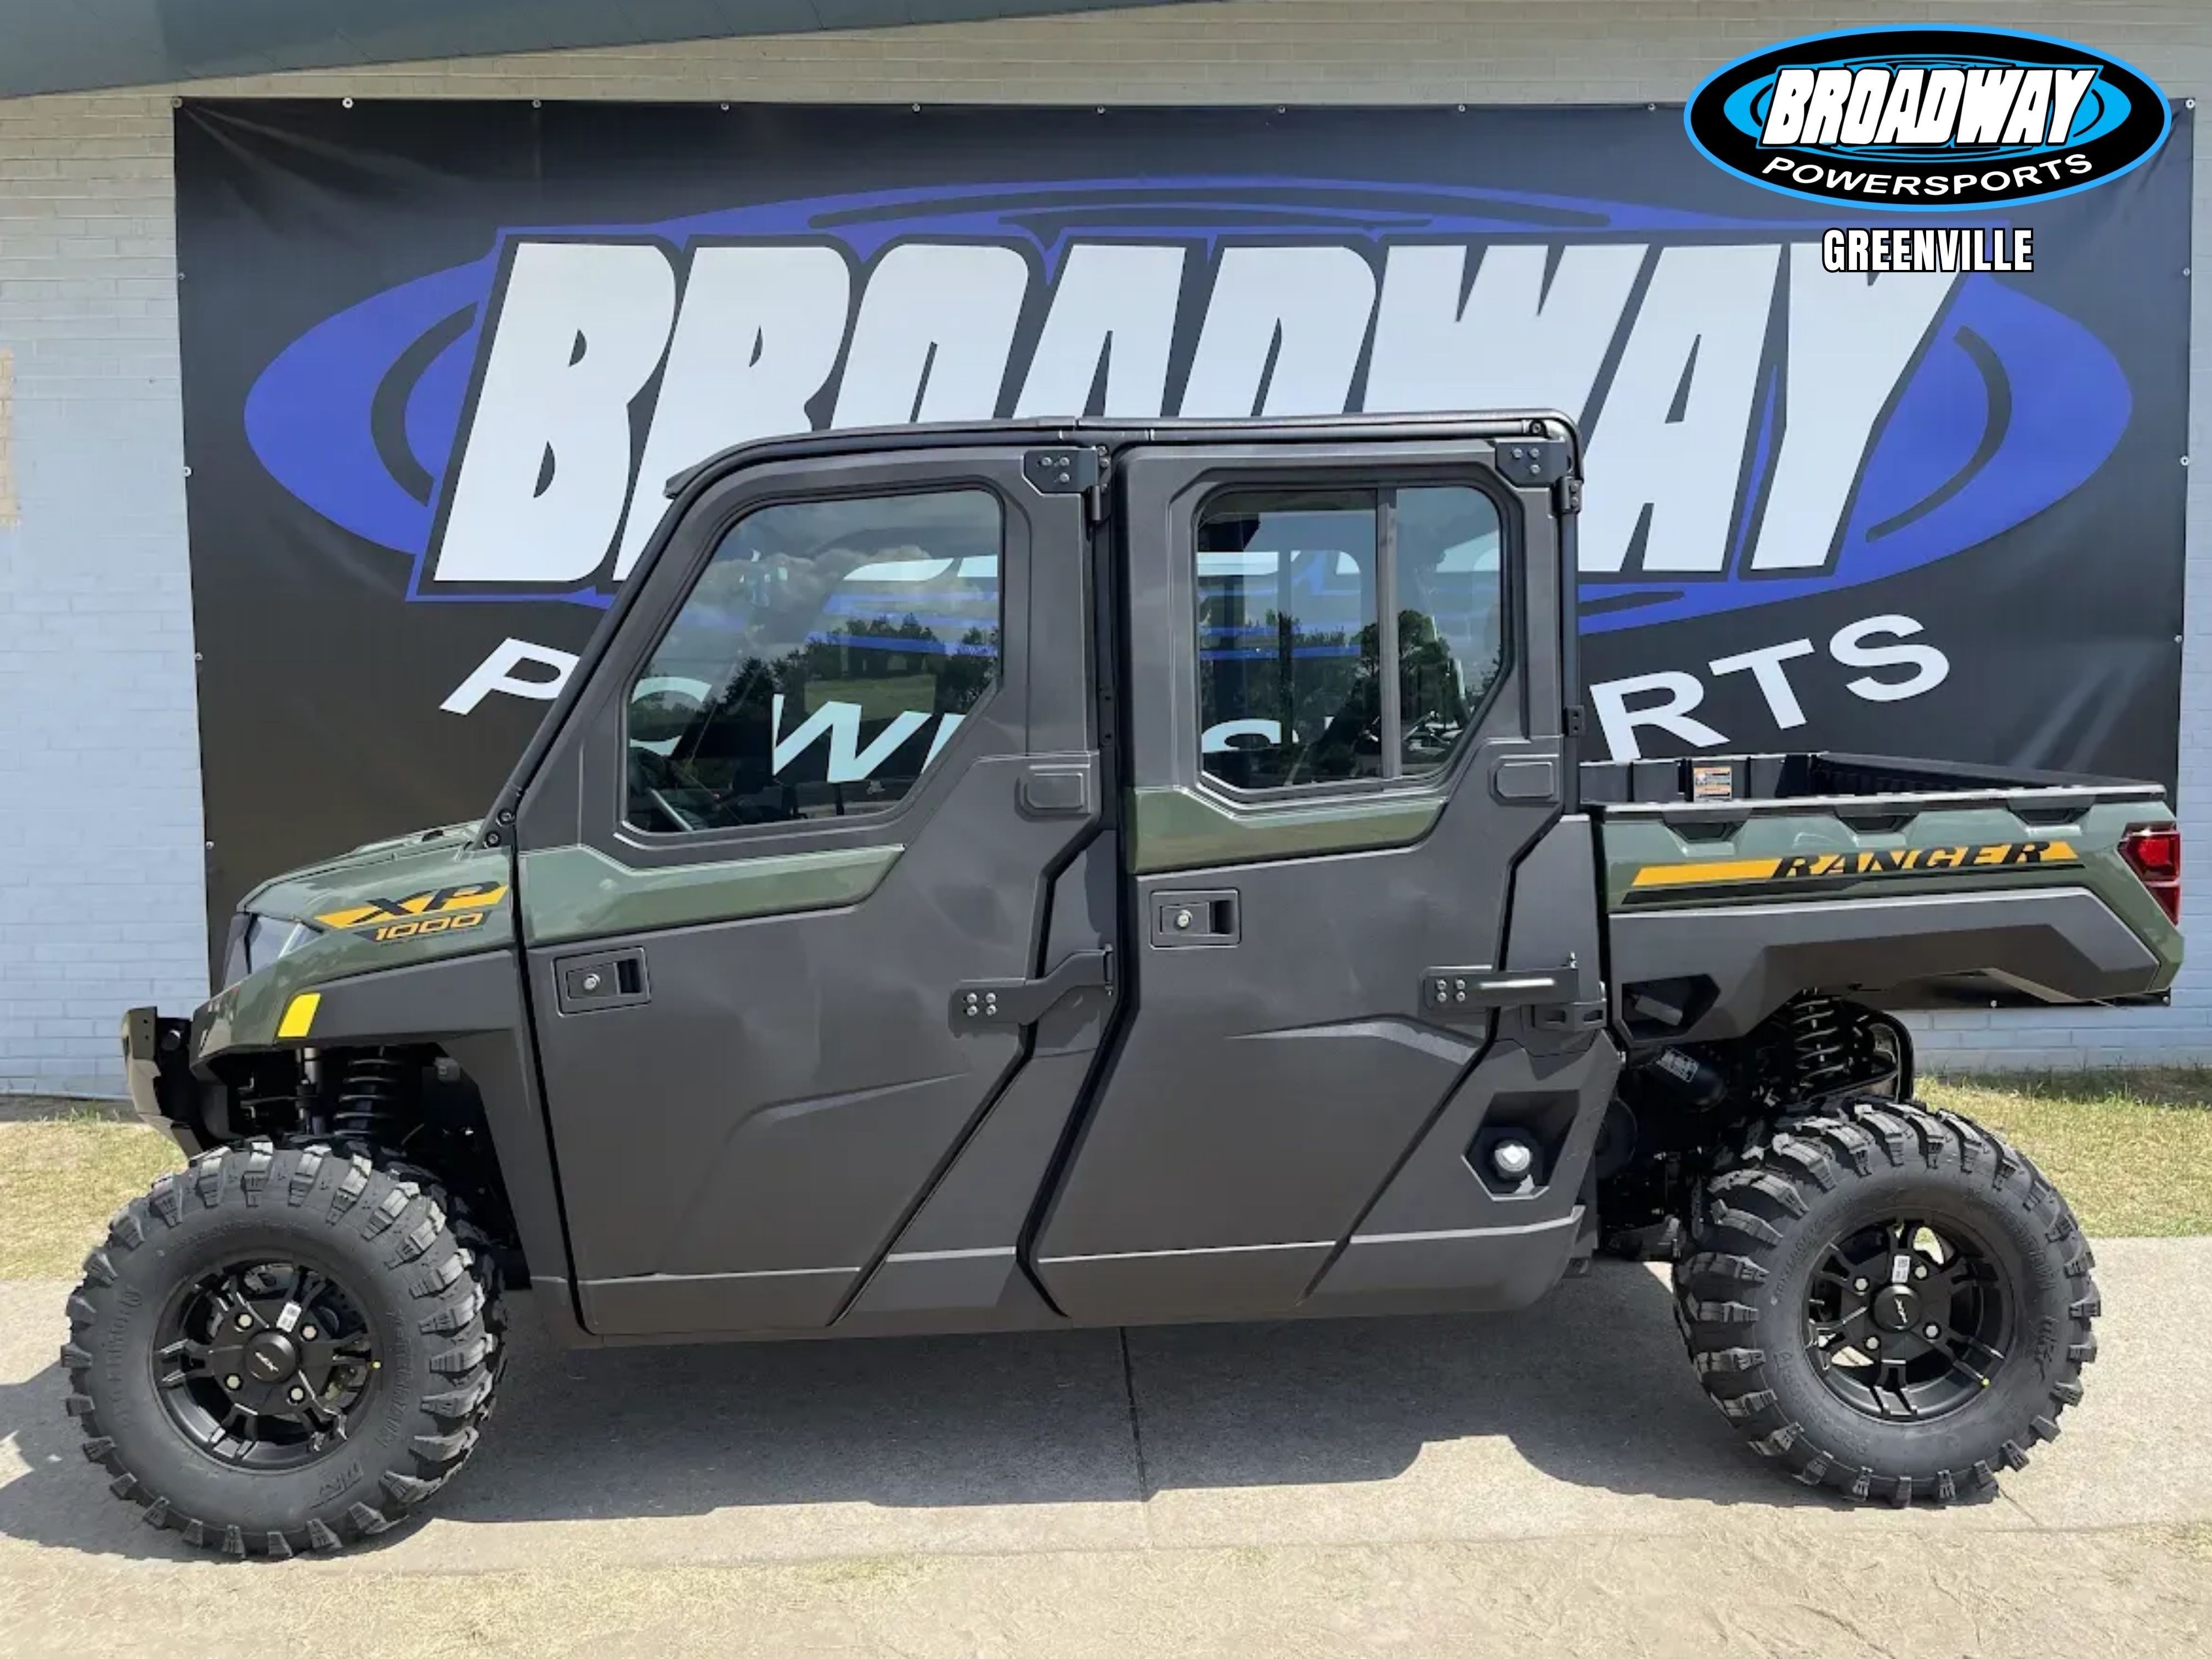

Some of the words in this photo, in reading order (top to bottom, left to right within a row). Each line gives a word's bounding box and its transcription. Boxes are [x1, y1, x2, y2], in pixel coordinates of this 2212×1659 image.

[1771, 840, 2051, 879] RANGER
[347, 881, 502, 926] XP
[374, 912, 486, 942] 1000
